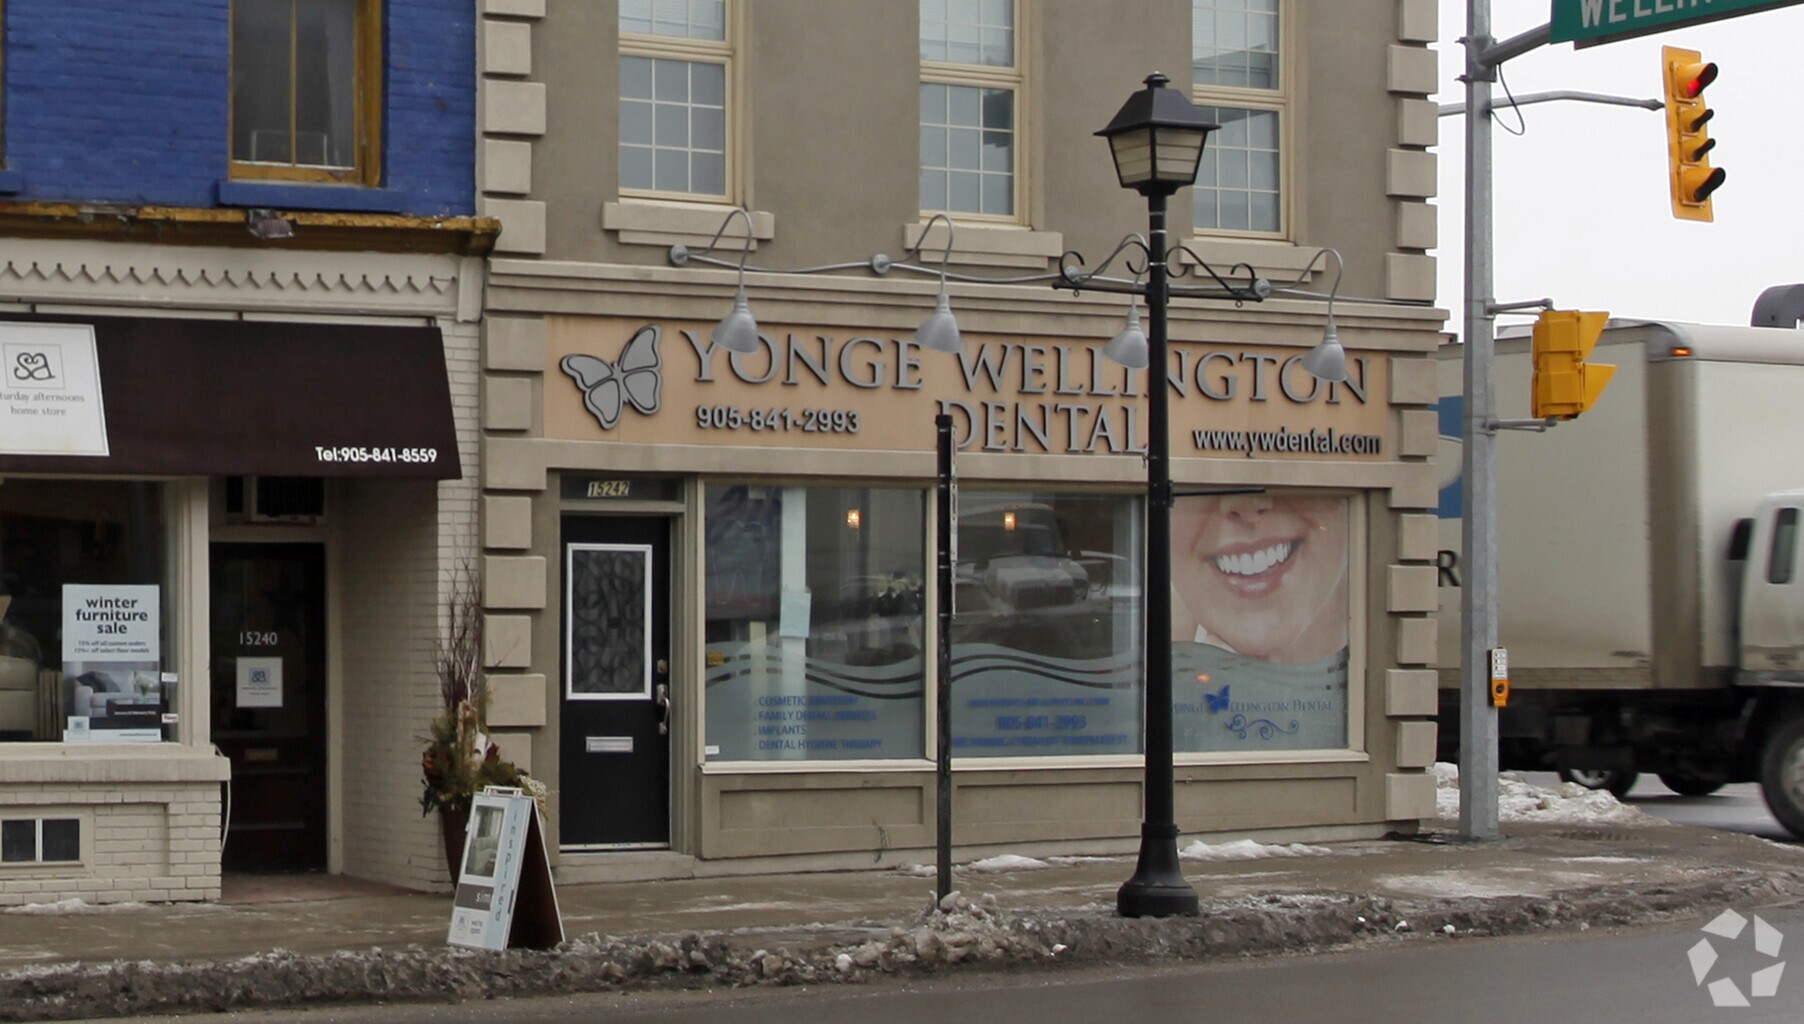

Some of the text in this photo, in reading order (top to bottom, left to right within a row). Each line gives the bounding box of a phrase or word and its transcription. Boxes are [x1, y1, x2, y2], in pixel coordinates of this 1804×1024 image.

[680, 330, 1370, 405] YONGE WELLINGTON
[33, 391, 85, 403] afternoons
[10, 406, 66, 416] home store
[695, 404, 860, 434] 905-841-2993
[935, 399, 1149, 455] DENTAL
[1192, 427, 1383, 458] www.ywdental.com
[315, 446, 438, 463] Tel:905-841-8559
[589, 480, 630, 497] 15242
[86, 595, 138, 609] winter
[75, 608, 148, 622] furniture
[96, 622, 128, 635] sale
[239, 631, 278, 646] 15240
[759, 695, 806, 706] COSMETIC
[759, 710, 794, 721] FAMILY
[758, 724, 807, 736] IMPLANTS
[759, 739, 796, 750] DENTAL
[494, 808, 519, 922] inspired
